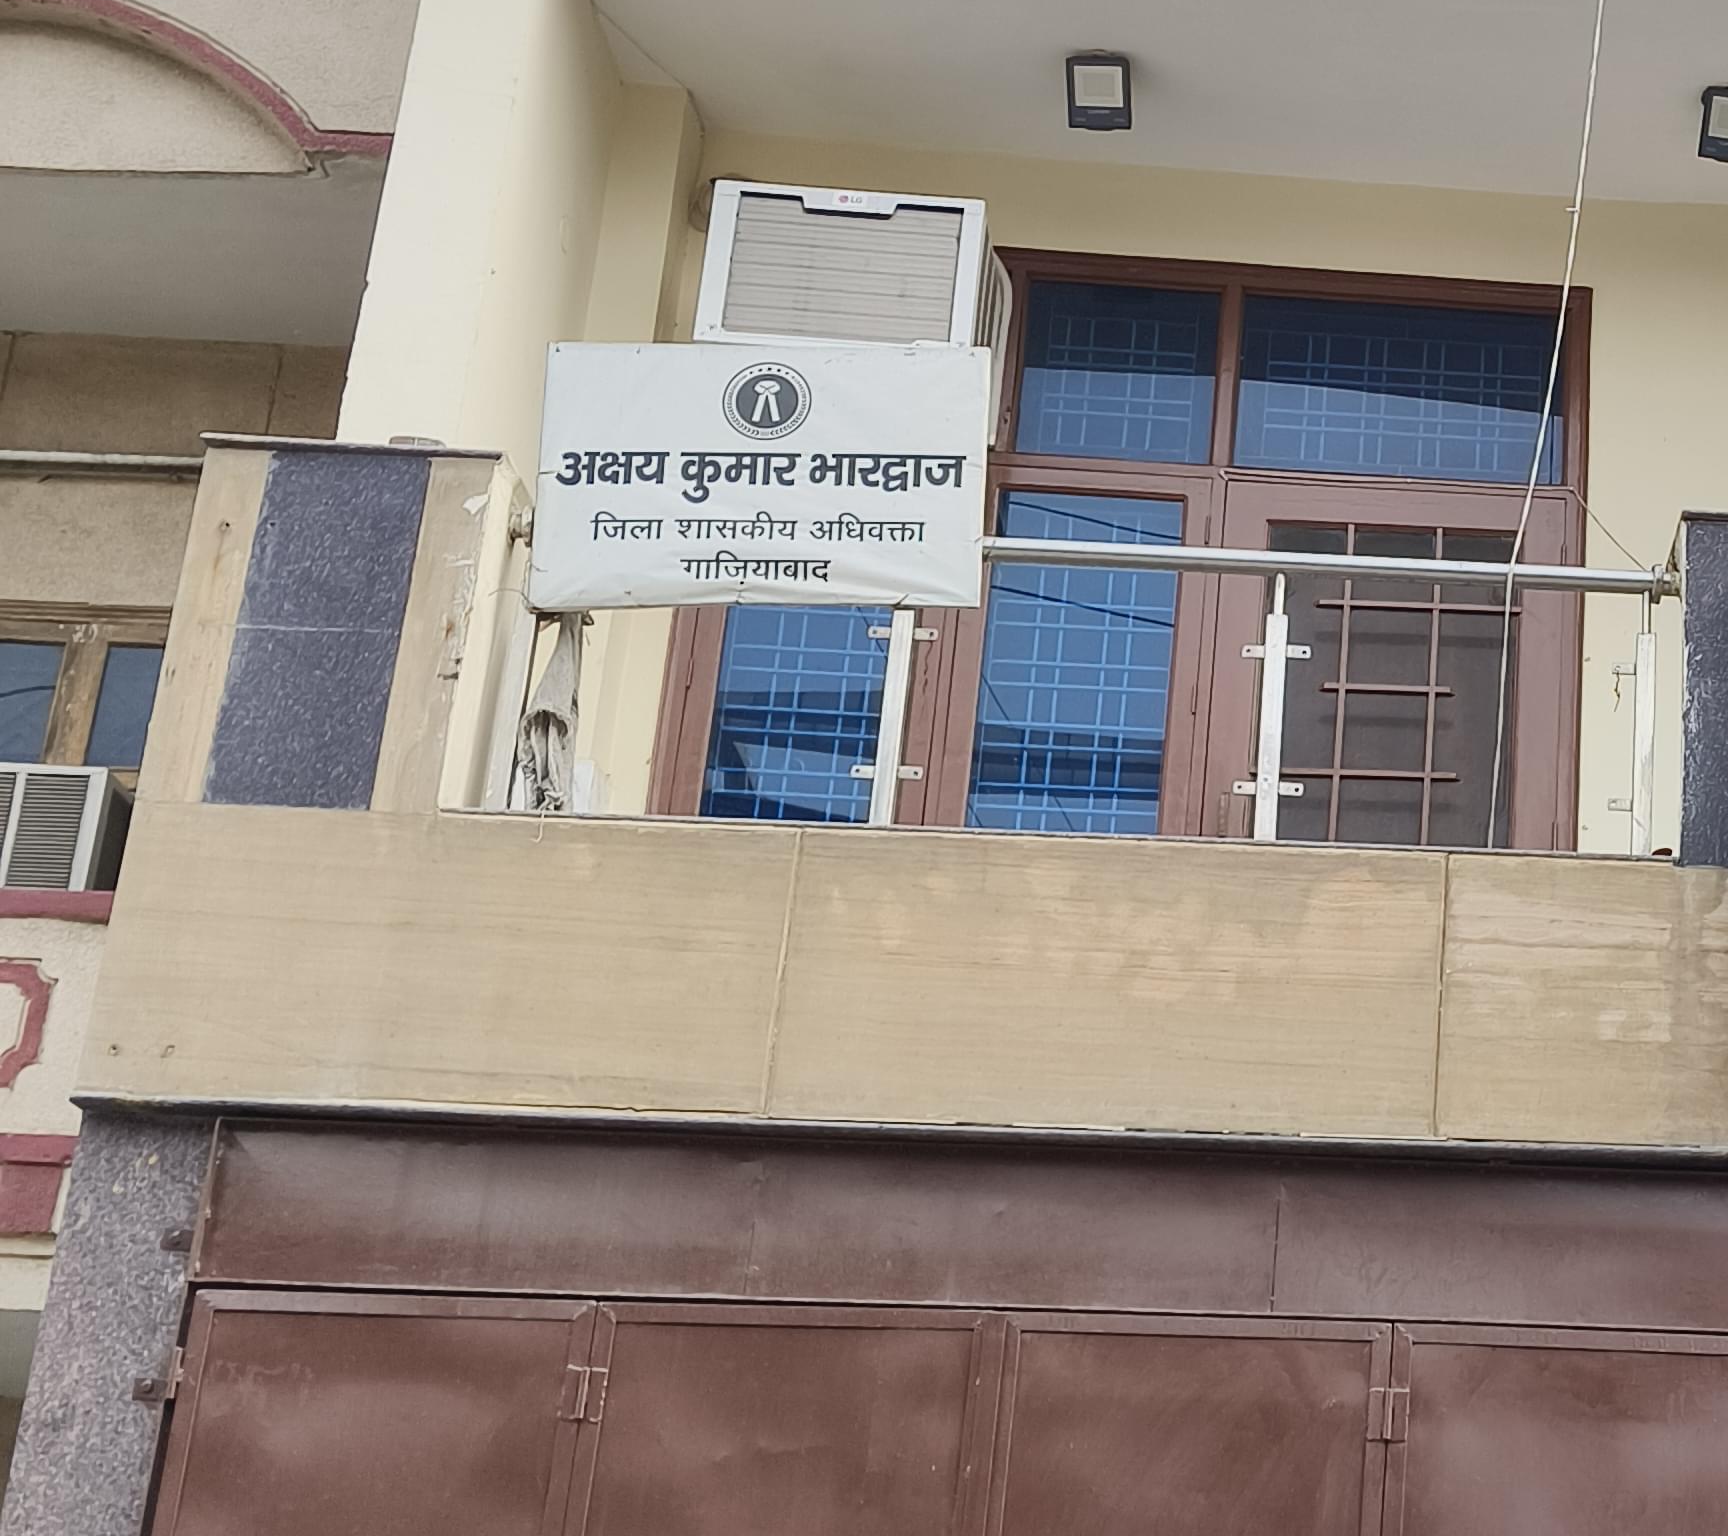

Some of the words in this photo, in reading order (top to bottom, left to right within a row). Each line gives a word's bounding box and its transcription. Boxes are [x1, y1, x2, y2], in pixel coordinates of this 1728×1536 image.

[555, 451, 669, 485] अक्षय
[681, 452, 801, 503] कुमार
[809, 454, 966, 491] भारद्वाज
[591, 512, 663, 541] जिला
[674, 511, 797, 543] शासकीय
[809, 512, 925, 543] अधिवक्ता
